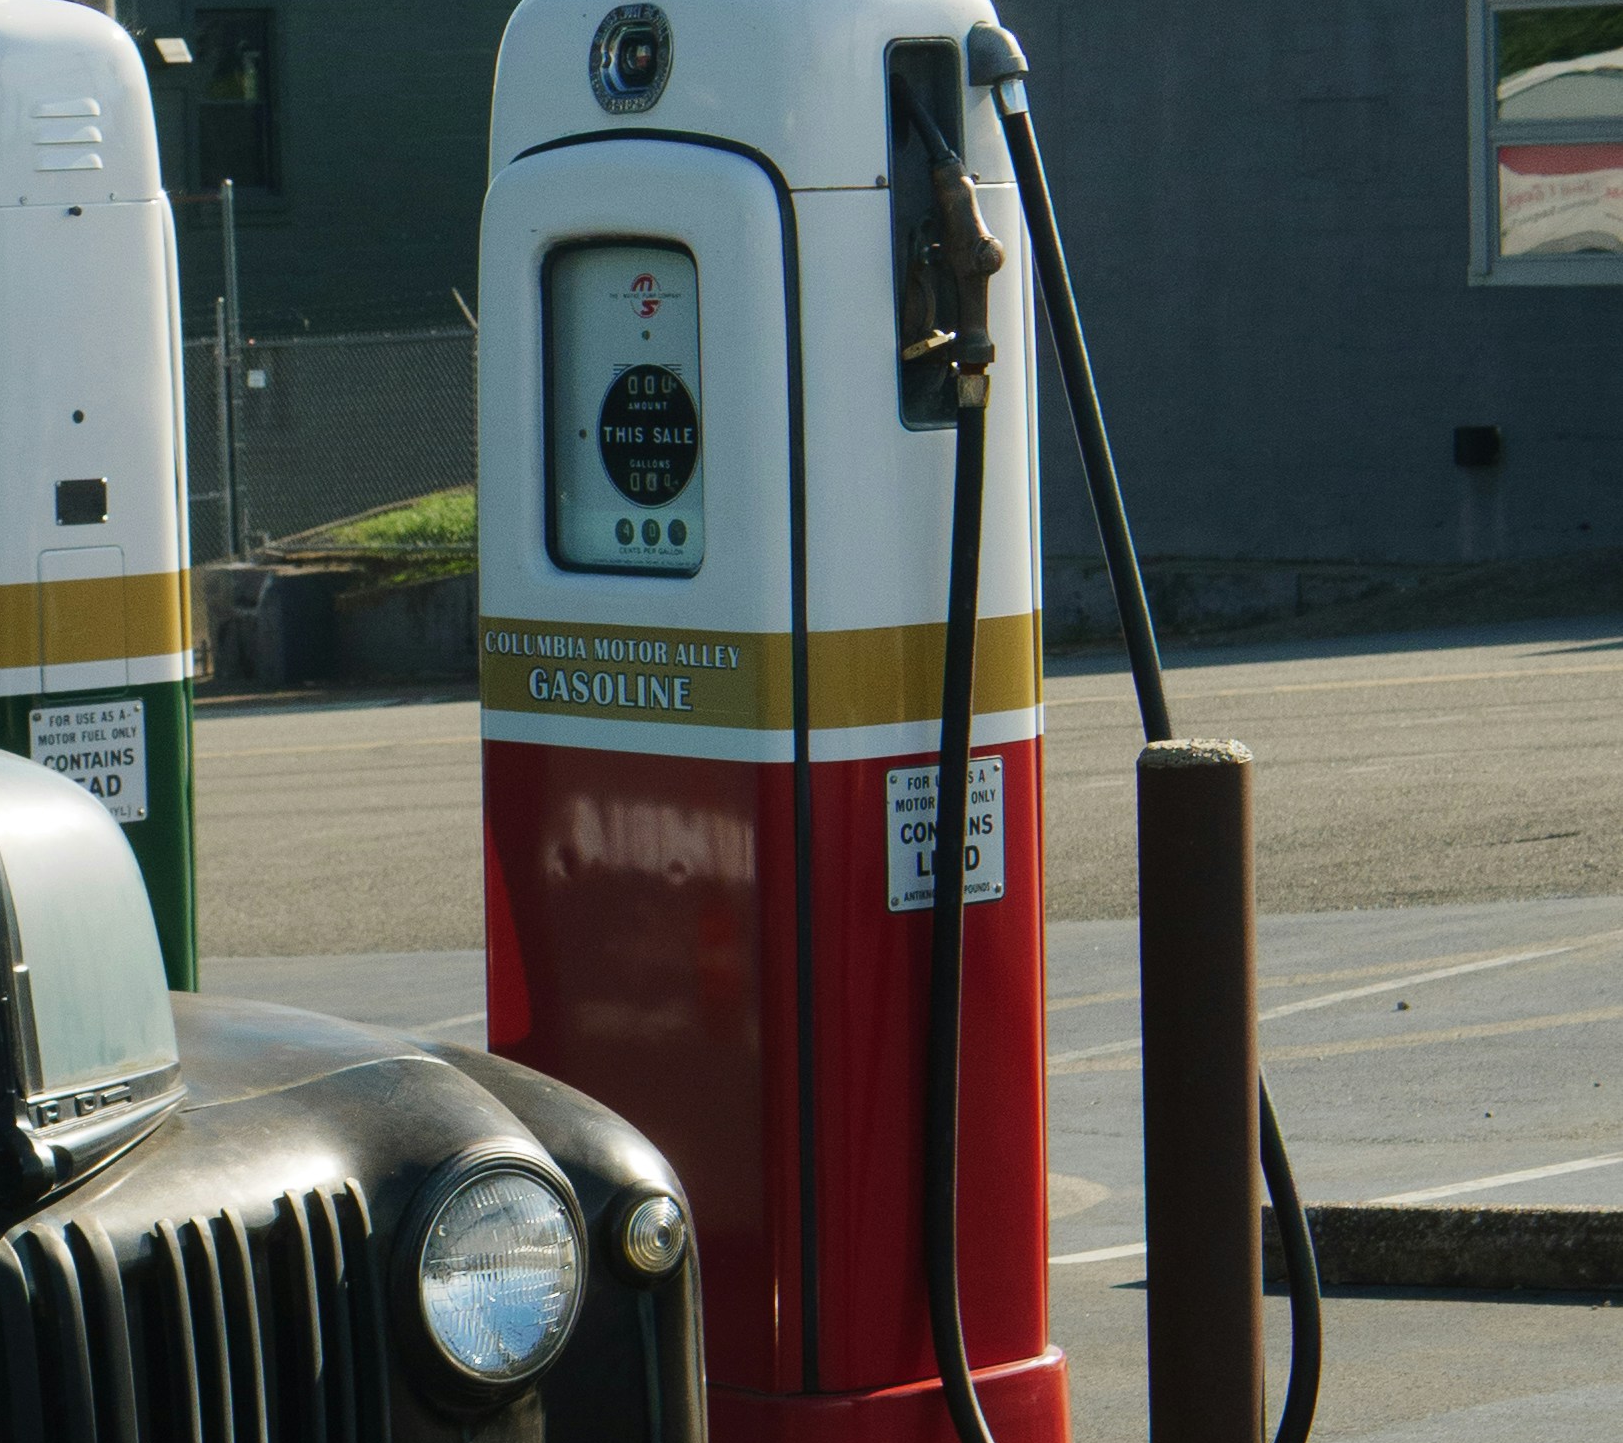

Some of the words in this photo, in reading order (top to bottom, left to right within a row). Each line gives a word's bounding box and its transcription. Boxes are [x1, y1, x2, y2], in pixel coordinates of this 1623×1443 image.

[627, 401, 668, 411] AMOUNT
[602, 426, 645, 443] THIS
[653, 426, 694, 444] SALE
[629, 459, 671, 469] GALLONS
[485, 630, 588, 661] COLUMBIA
[593, 637, 669, 665] MOTOR
[674, 643, 741, 670] ALLEY
[528, 666, 694, 711] GASOLINE
[49, 714, 71, 727] FOR
[75, 711, 96, 725] USE
[100, 710, 115, 723] AS
[38, 732, 76, 746] MOTOR
[81, 728, 107, 742] FUEL
[111, 726, 137, 740] ONLY
[43, 747, 135, 772] CONTAINS
[73, 774, 122, 798] AD
[907, 775, 930, 791] FOR
[978, 769, 986, 783] A
[895, 796, 936, 813] MOTOR
[971, 788, 996, 804] ONLY
[900, 813, 994, 845] CONNS
[916, 845, 981, 878] LD
